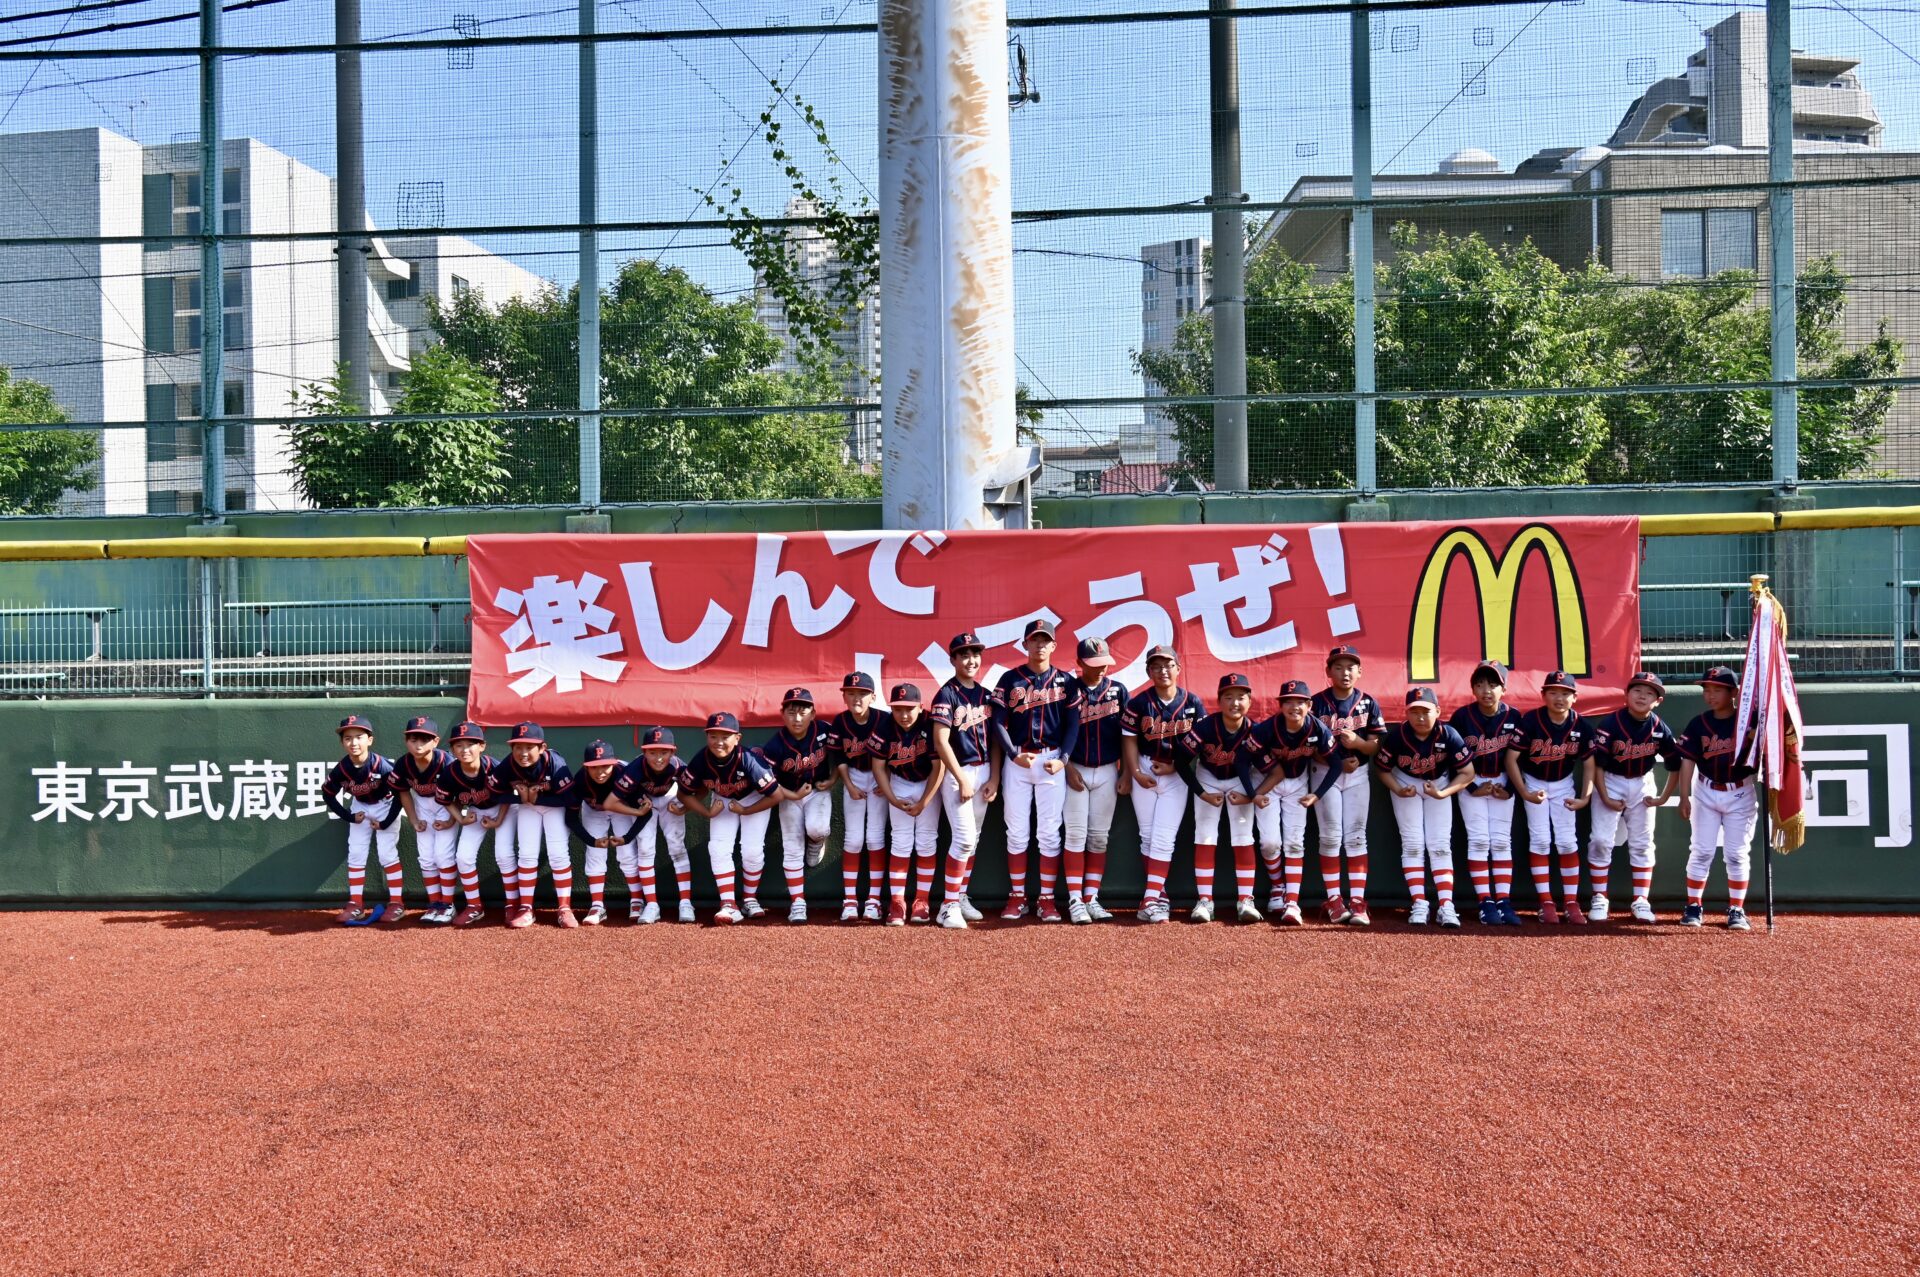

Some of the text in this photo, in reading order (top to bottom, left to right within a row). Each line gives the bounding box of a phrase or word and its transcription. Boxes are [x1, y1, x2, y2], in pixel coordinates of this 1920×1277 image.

[493, 530, 949, 699] 楽しんで
[1036, 620, 1044, 630] P
[964, 634, 972, 645] P
[1340, 645, 1347, 655] P
[1556, 672, 1565, 682] P
[1646, 672, 1655, 682] P
[1710, 668, 1720, 678] P
[852, 675, 860, 686] P
[1229, 674, 1238, 685] P
[1287, 682, 1296, 693] P
[793, 689, 801, 698] P
[899, 688, 906, 698] P
[348, 715, 357, 725] P
[416, 717, 426, 727] P
[715, 715, 724, 725] P
[460, 726, 468, 736] P
[520, 726, 528, 736] P
[655, 731, 663, 741] P
[596, 747, 604, 758] P
